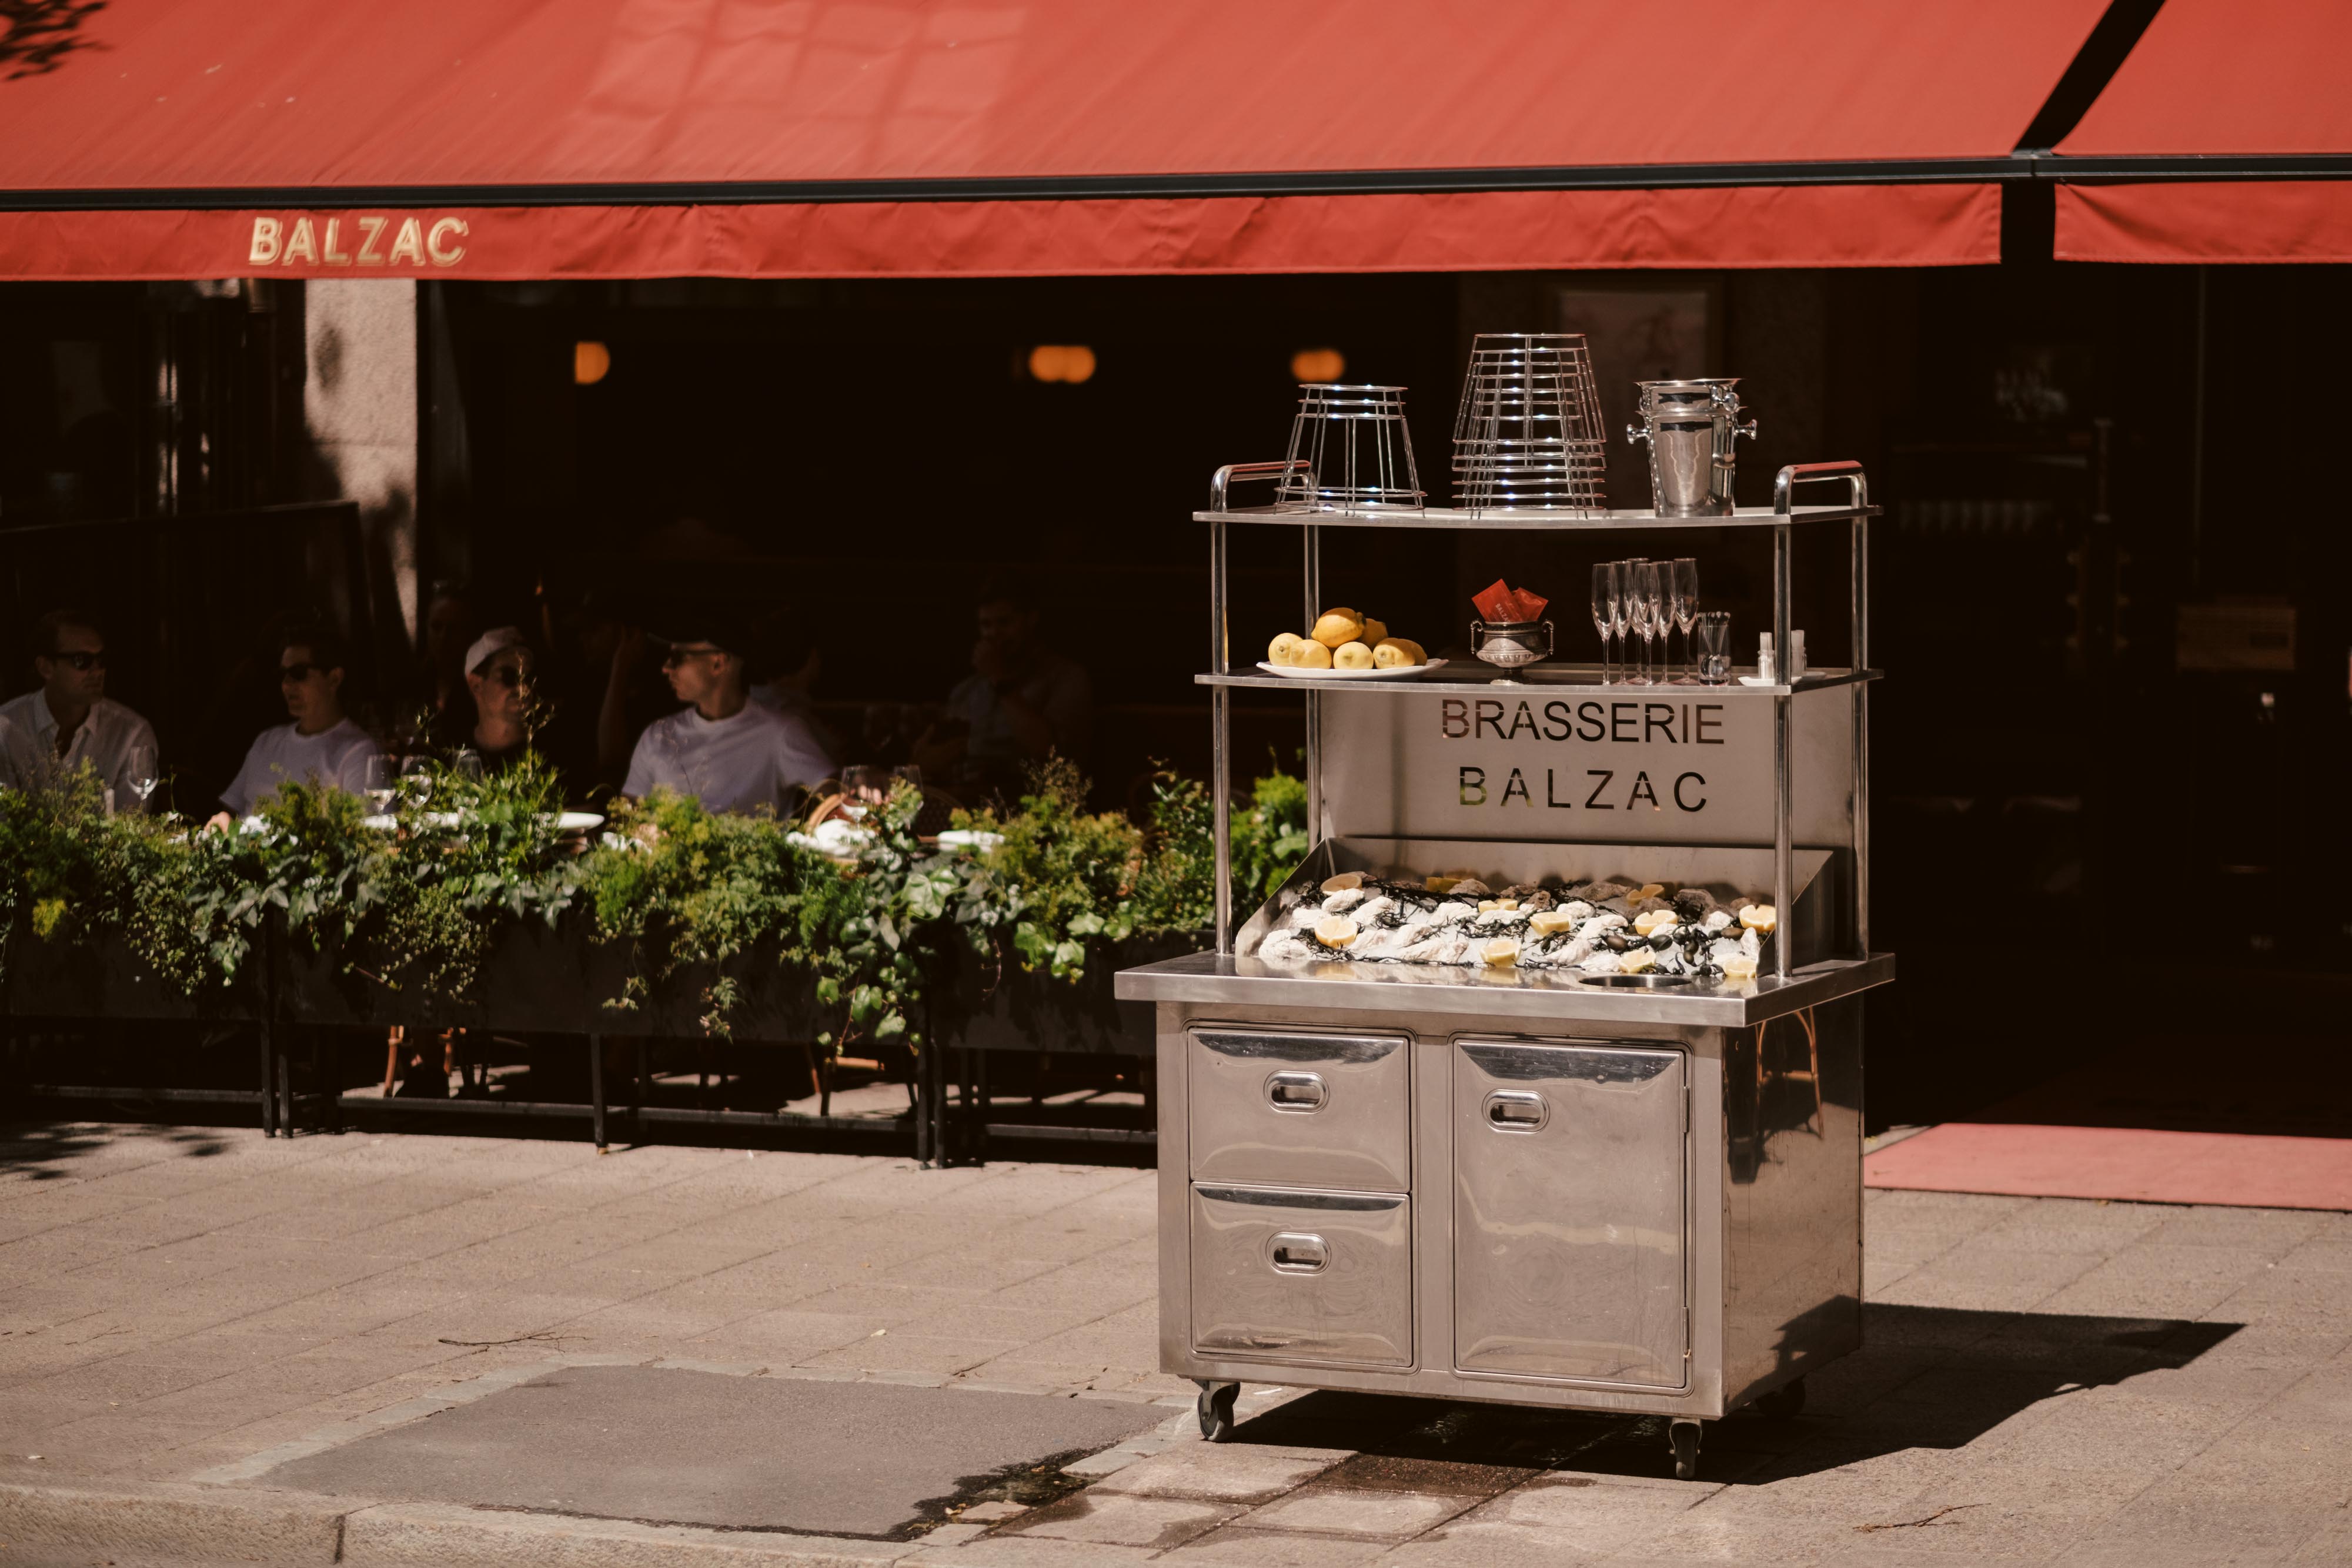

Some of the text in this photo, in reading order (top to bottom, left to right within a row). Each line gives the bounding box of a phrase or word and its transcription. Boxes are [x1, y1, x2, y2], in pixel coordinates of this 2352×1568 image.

[249, 216, 469, 267] BALZAC
[1442, 699, 1725, 744] BRASSERIE
[1459, 766, 1707, 812] BALZAC
